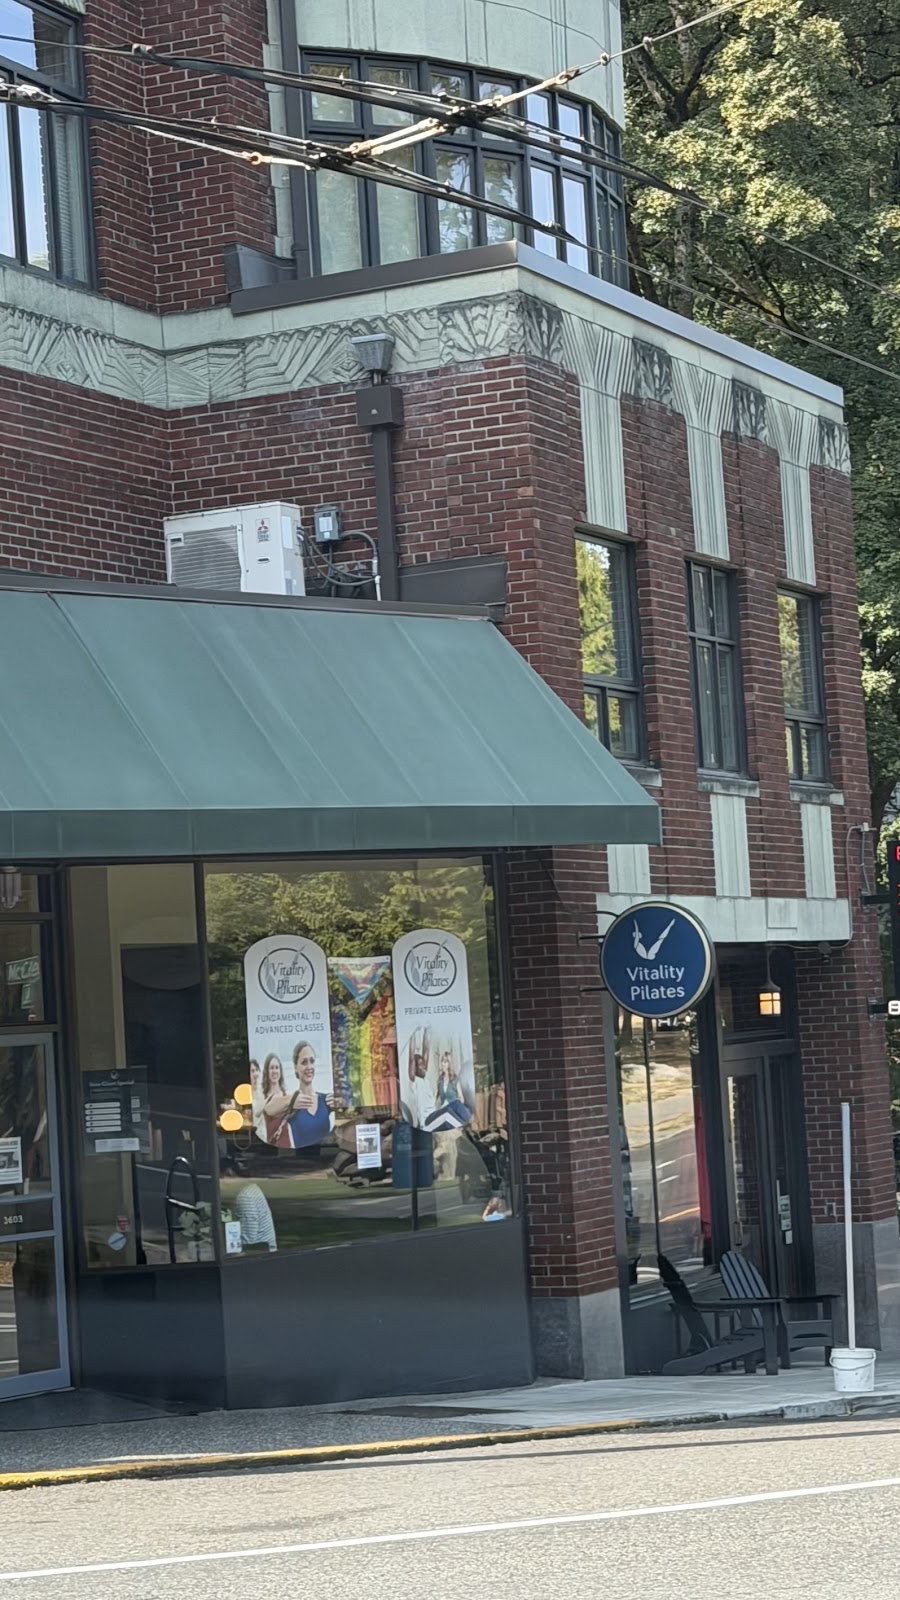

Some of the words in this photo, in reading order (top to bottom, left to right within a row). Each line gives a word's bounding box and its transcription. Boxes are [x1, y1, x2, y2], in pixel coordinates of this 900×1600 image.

[271, 961, 307, 979] Vitality
[417, 955, 448, 972] Vitality
[421, 972, 449, 987] Pilates
[626, 964, 685, 982] Vitality
[276, 979, 307, 994] Pilates
[630, 984, 685, 1001] Pilates
[257, 1012, 310, 1022] FUNDAMENTAL
[311, 1011, 321, 1020] TO
[404, 1006, 432, 1015] PRIVATE
[433, 1004, 462, 1014] LESSONS
[255, 1024, 294, 1034] ADVANCED
[295, 1022, 325, 1032] CLASSES
[4, 1214, 23, 1225] 3603
